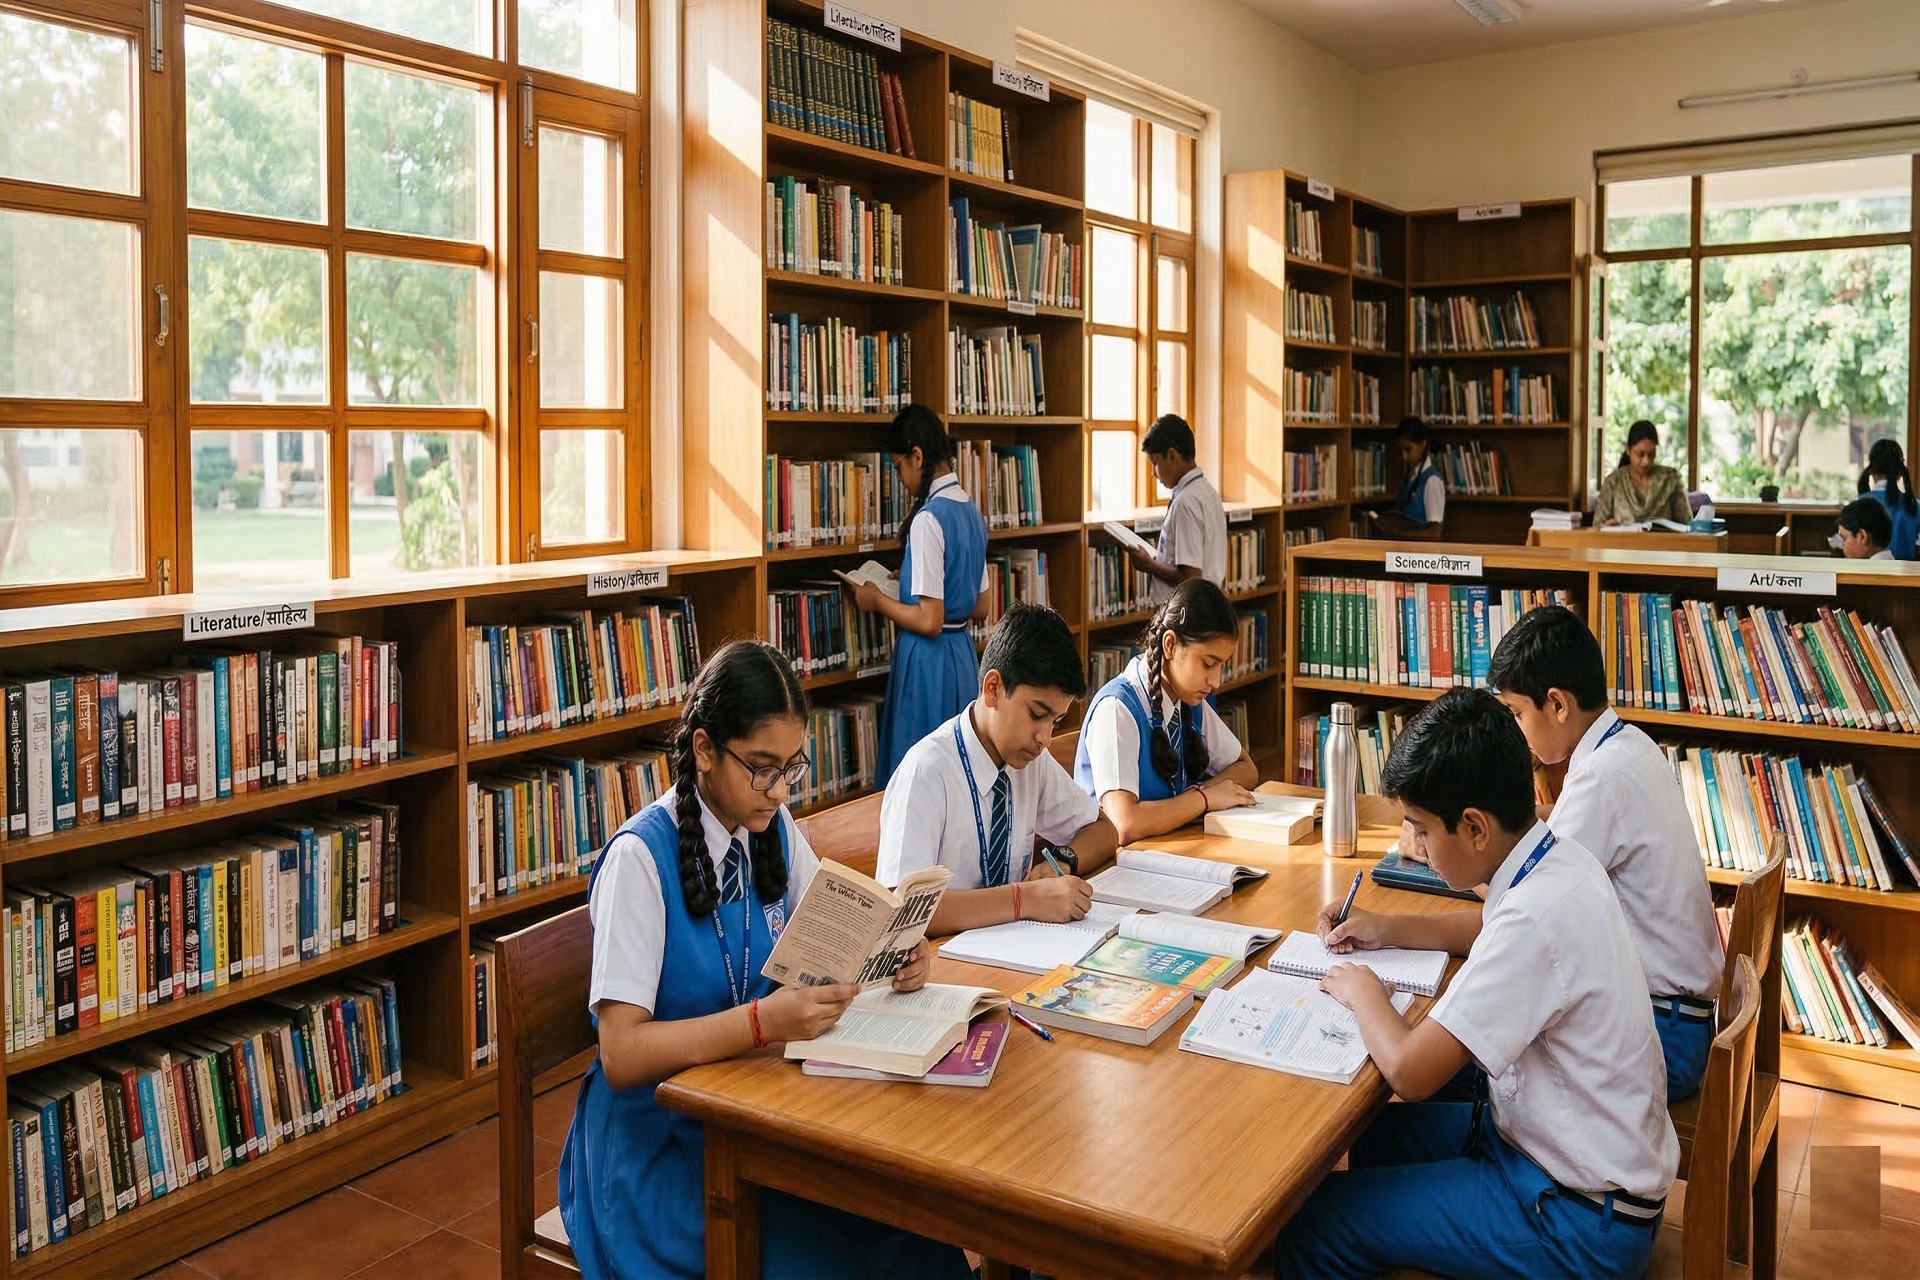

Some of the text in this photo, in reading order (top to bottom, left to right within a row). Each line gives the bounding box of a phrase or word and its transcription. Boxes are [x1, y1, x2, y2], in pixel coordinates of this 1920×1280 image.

[1394, 555, 1471, 571] Science/विज्ञान
[593, 569, 660, 590] History/इतिहास
[1749, 573, 1803, 587] Art/कला
[190, 604, 308, 633] Literature/साहित्य
